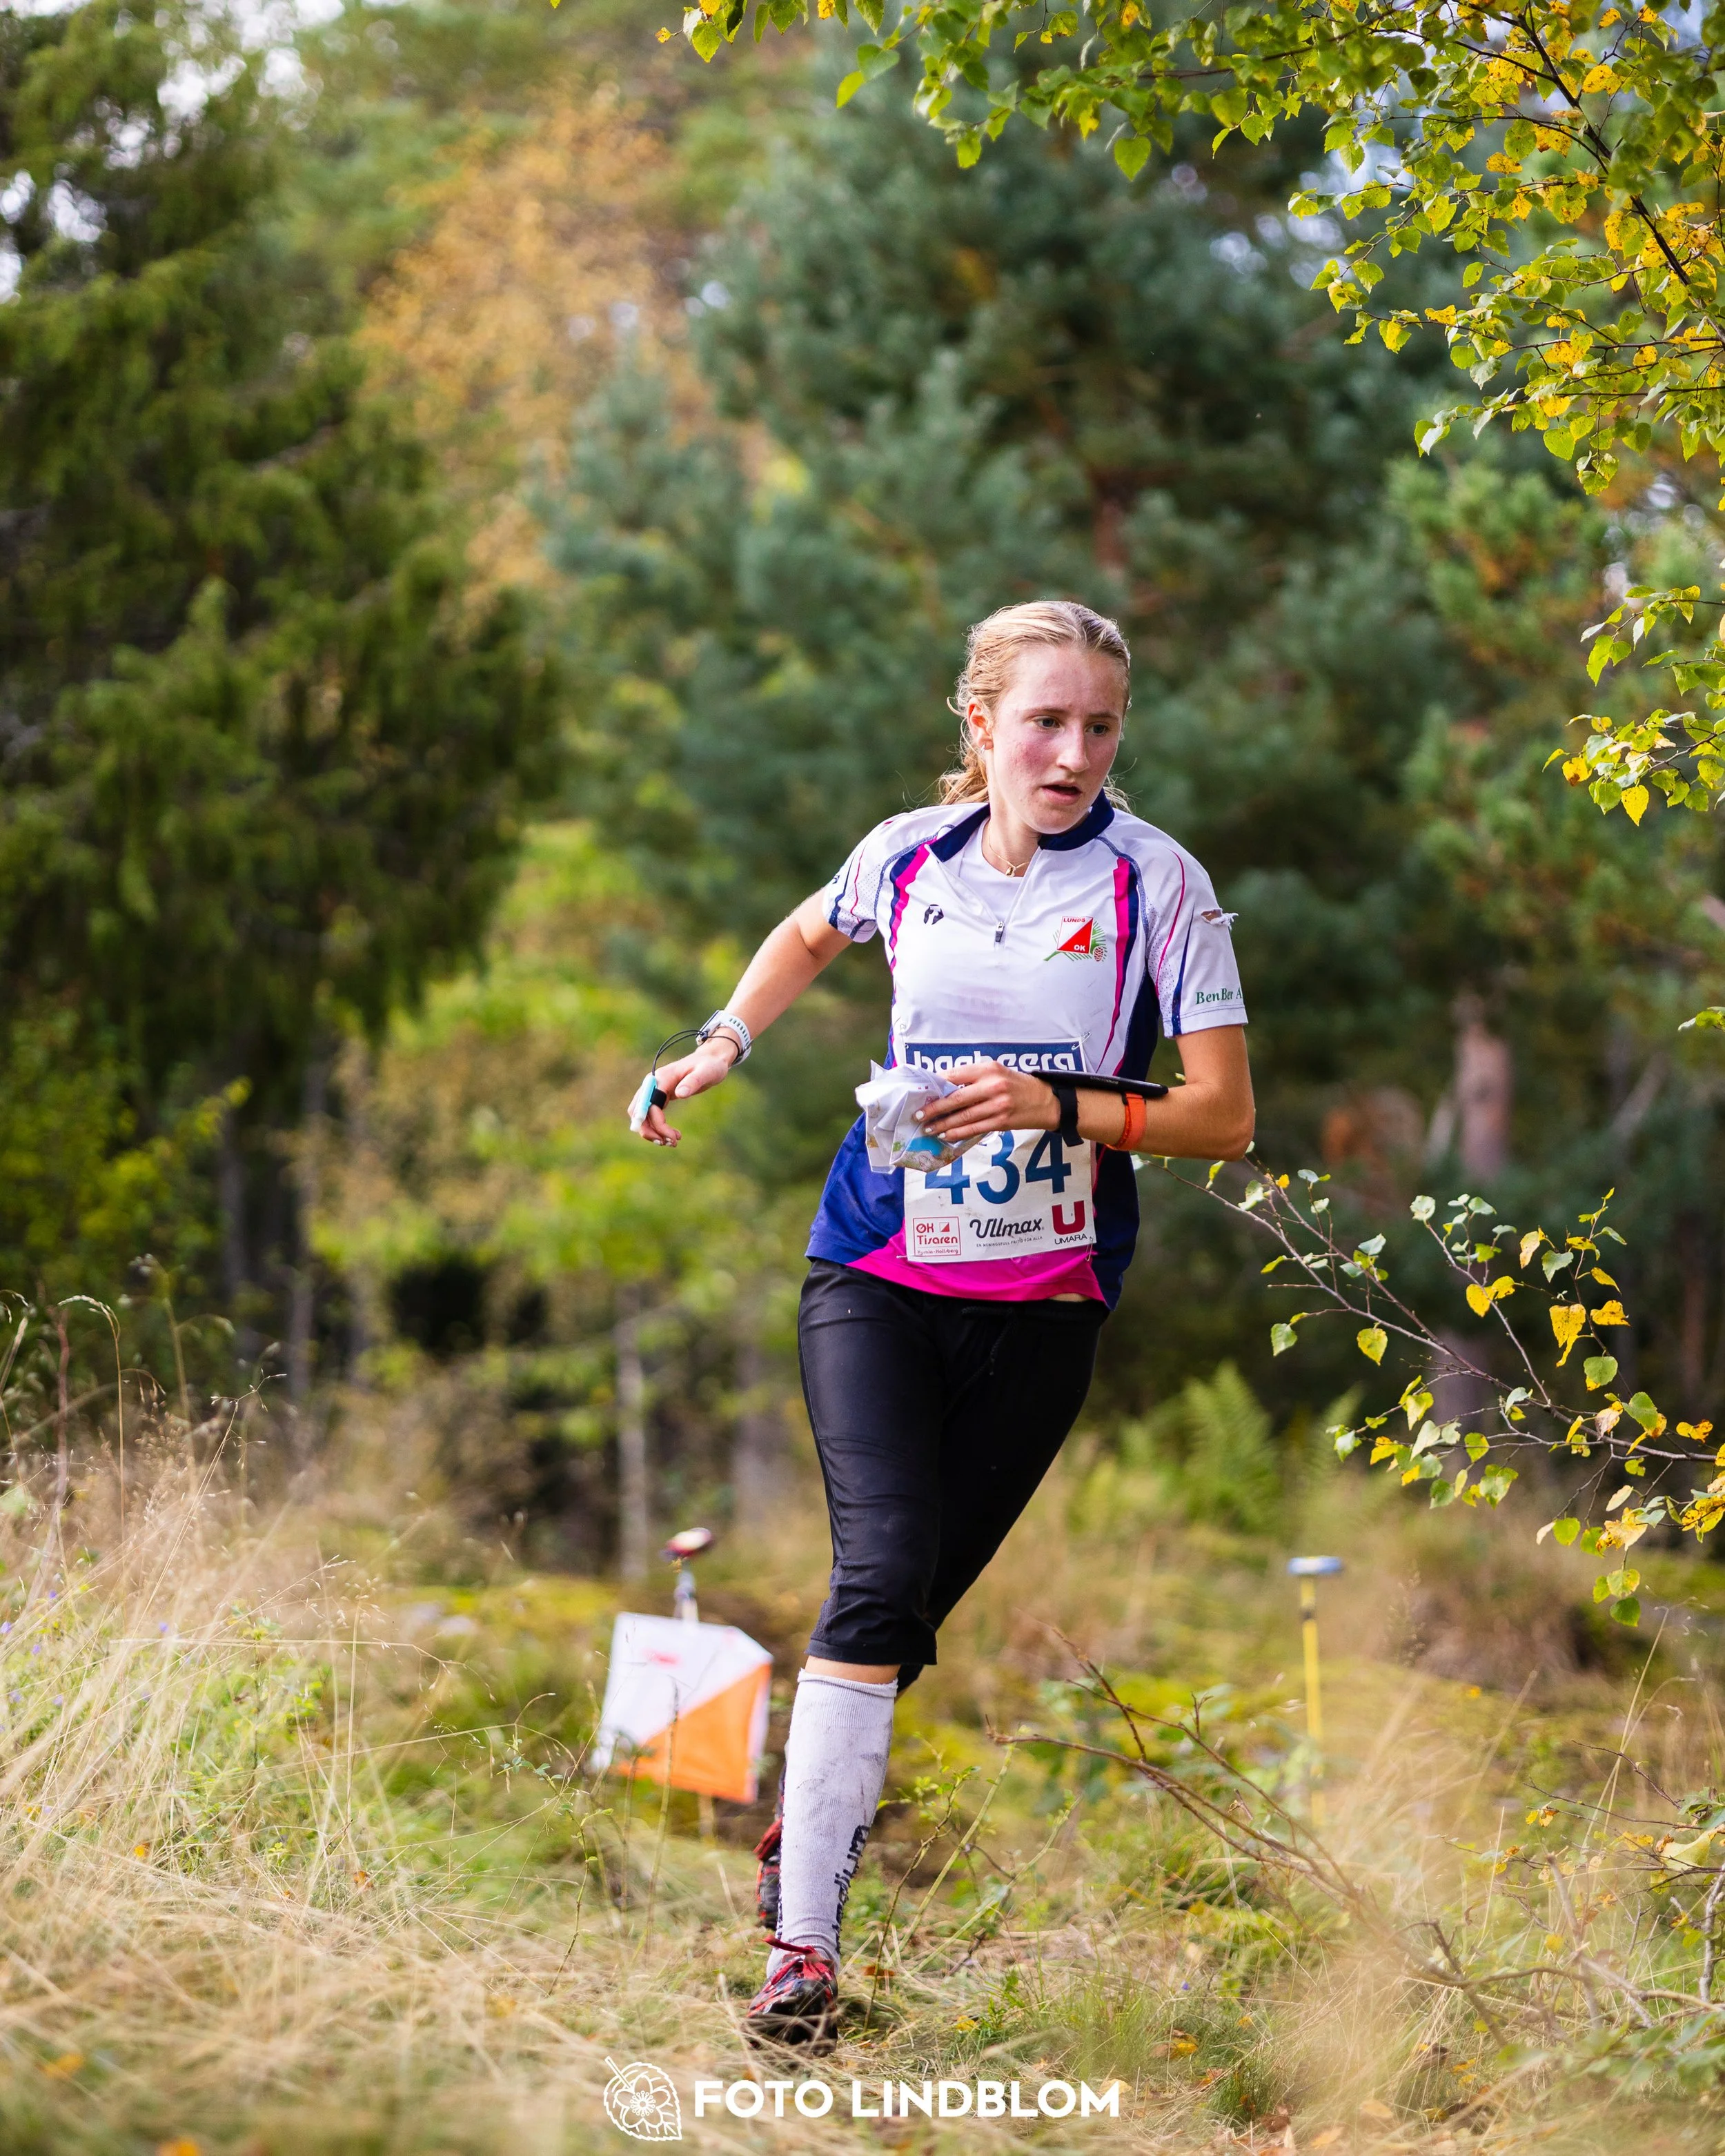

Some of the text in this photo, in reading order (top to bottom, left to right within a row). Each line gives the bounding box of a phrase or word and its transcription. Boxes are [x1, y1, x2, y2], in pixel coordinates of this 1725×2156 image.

[925, 1130, 1072, 1204] 434
[1052, 1200, 1085, 1235] U
[969, 1218, 1042, 1238] Ullmax
[917, 1235, 958, 1245] Tisaren
[1054, 1234, 1087, 1245] UMARA
